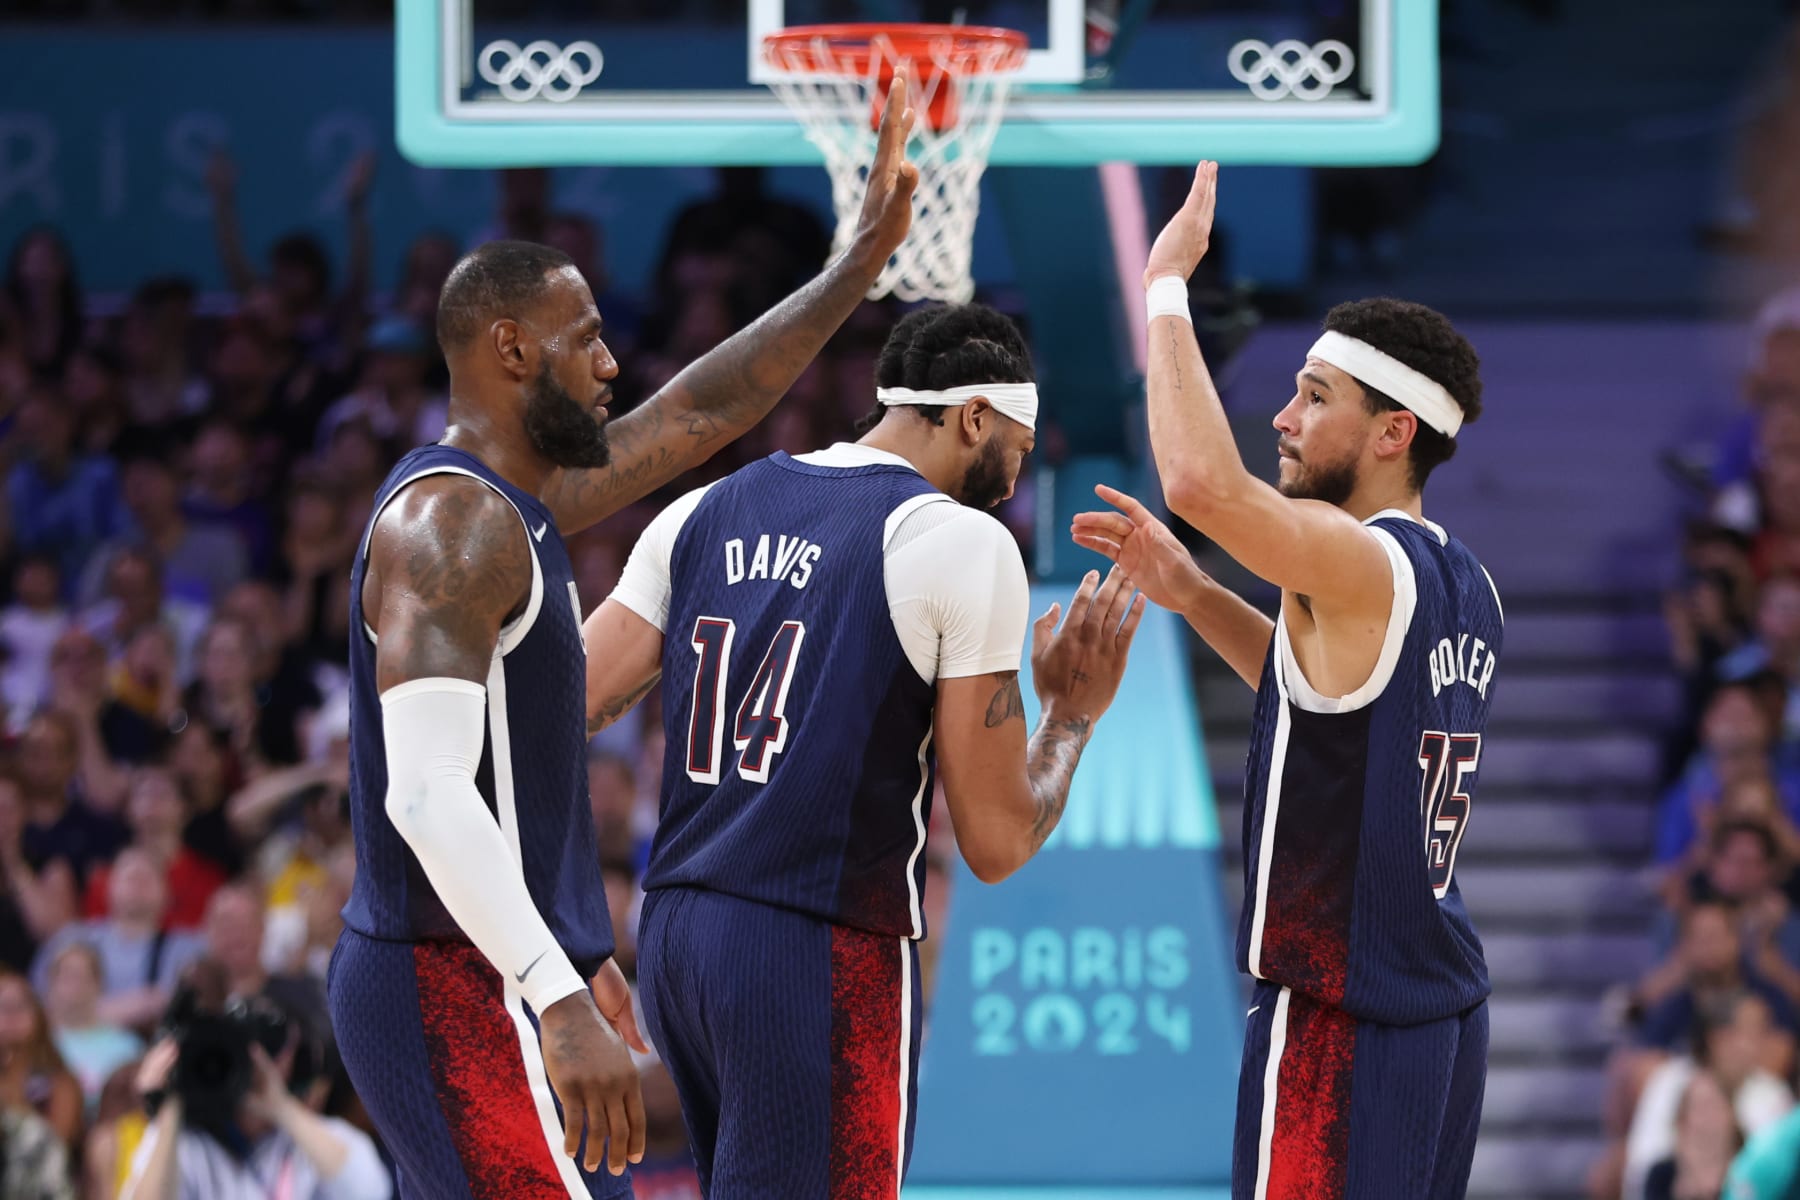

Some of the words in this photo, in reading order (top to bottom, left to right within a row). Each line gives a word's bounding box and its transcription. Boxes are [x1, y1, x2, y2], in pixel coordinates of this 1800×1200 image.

[725, 534, 821, 589] DAVIS
[686, 615, 805, 785] 14
[1418, 730, 1481, 899] 15
[972, 993, 1191, 1056] 2024
